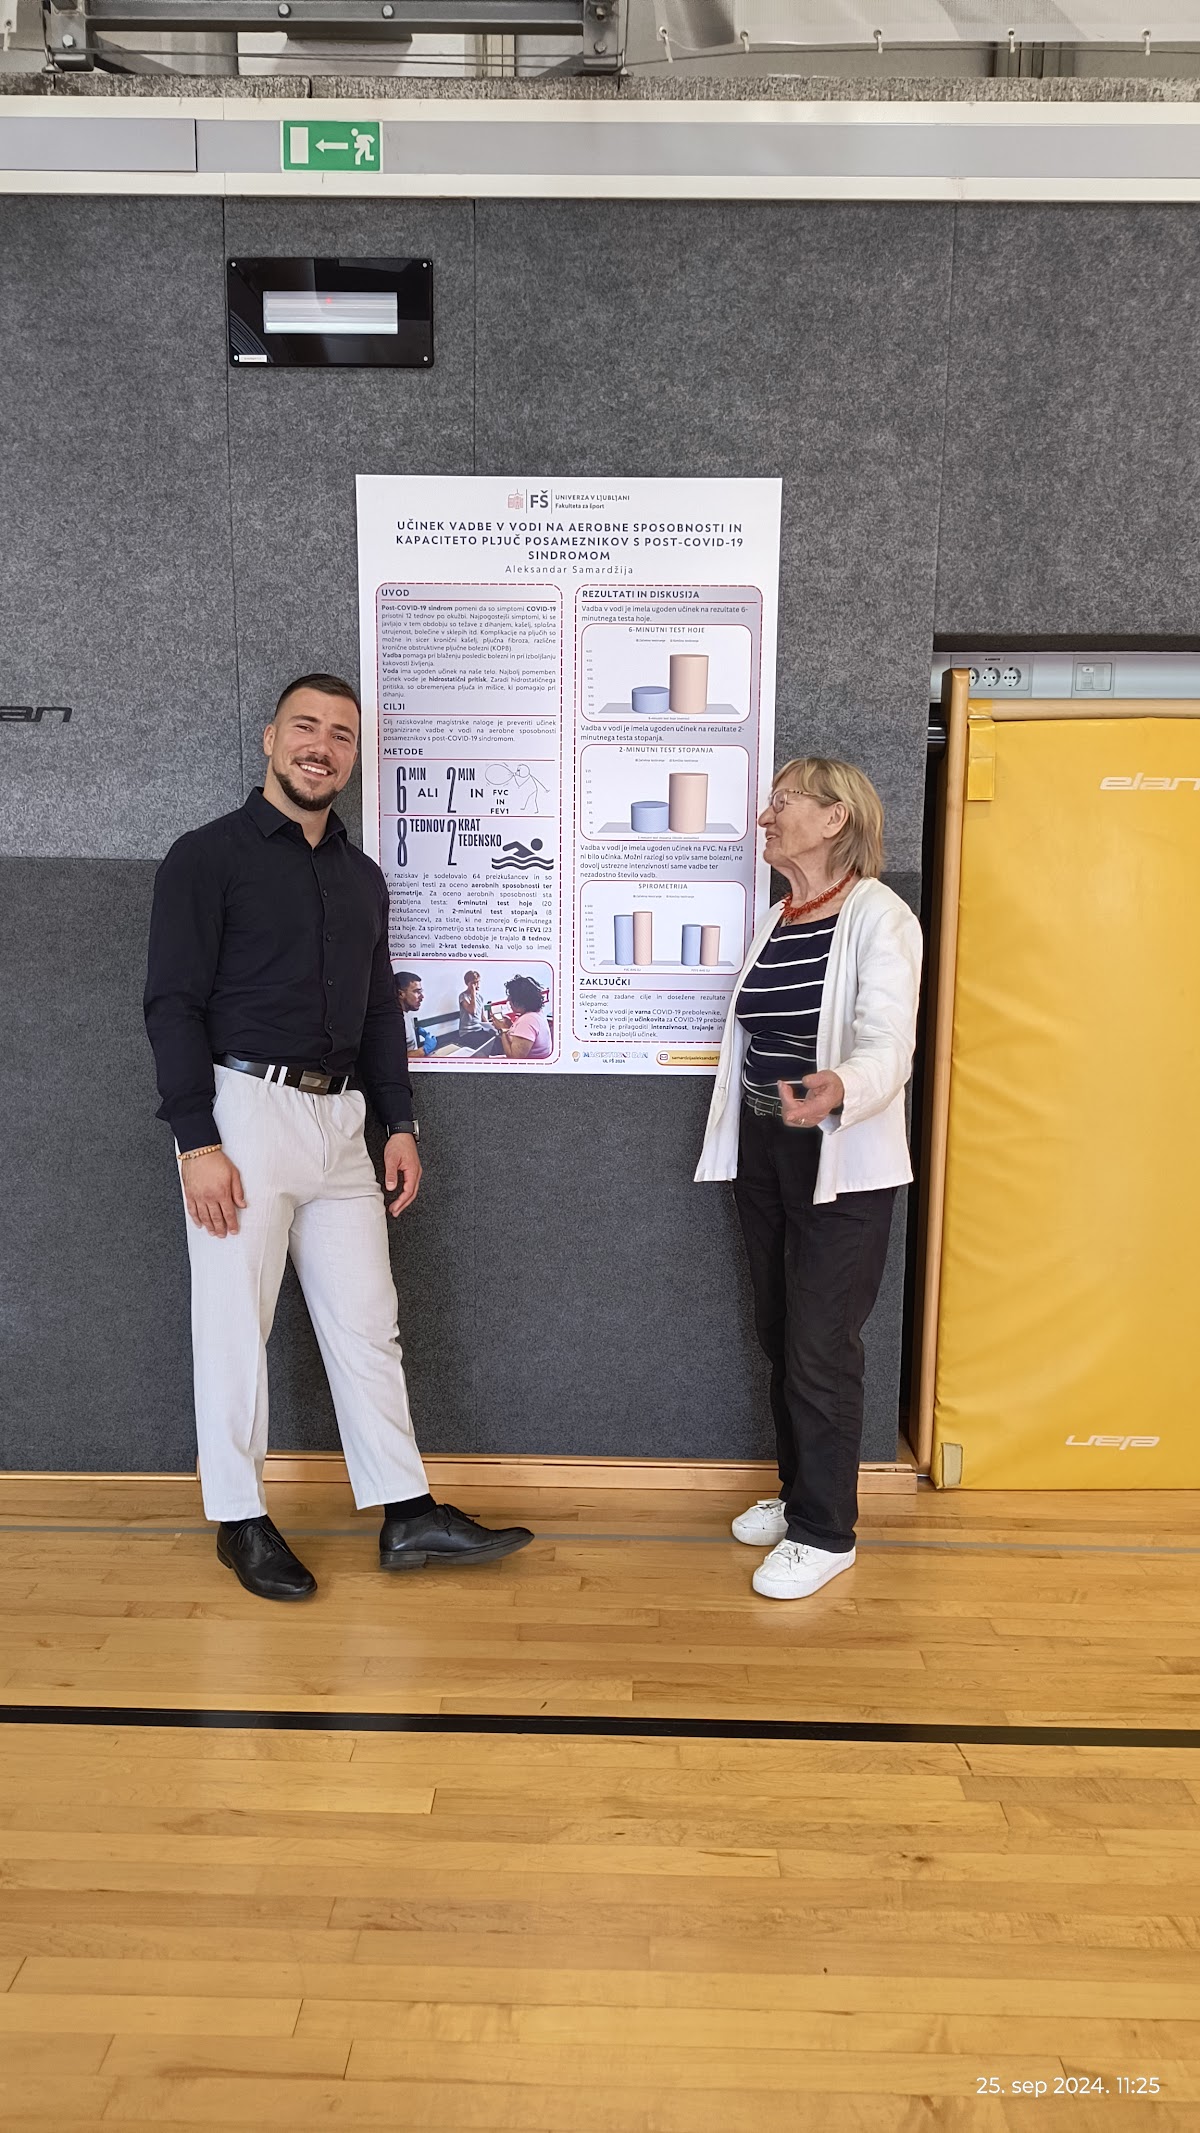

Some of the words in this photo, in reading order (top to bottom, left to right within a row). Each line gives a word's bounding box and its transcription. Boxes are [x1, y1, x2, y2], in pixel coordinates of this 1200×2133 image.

[530, 490, 549, 508] FŠ
[397, 518, 445, 531] UČINEK
[449, 521, 492, 531] VADBE
[509, 522, 541, 532] VODI
[546, 522, 564, 532] NA
[568, 522, 629, 532] AEROBNE
[633, 523, 724, 533] SPOSOBNOSTI
[729, 523, 742, 533] IN
[396, 535, 477, 545] KAPACITETO
[482, 533, 521, 546] PLJUČ
[525, 536, 629, 546] POSAMEZNIKOV
[633, 537, 640, 546] S
[644, 537, 743, 547] POST-COVID-19
[528, 550, 610, 560] SINDROMOM
[505, 565, 567, 573] Aleksandar
[572, 565, 633, 575] Samardžija
[381, 589, 410, 597] UVOD
[581, 615, 617, 623] minutnega
[617, 614, 635, 623] testa
[636, 615, 652, 623] hoje.
[0, 706, 72, 723] an
[623, 725, 630, 733] je
[580, 734, 615, 742] minutnega
[1098, 772, 1200, 791] elan
[396, 766, 407, 813] 6
[408, 767, 426, 781] MIN
[417, 788, 438, 798] ALI
[446, 766, 457, 813] 2
[458, 768, 475, 781] MIN
[470, 788, 484, 798] IN
[397, 817, 408, 867] 8
[410, 819, 445, 833] TEDNOV
[447, 819, 457, 866] 2
[458, 819, 480, 832] KRAT
[458, 834, 502, 847] TEDENSKO
[621, 844, 628, 852] je
[579, 976, 631, 986] ZAKLJUČKI
